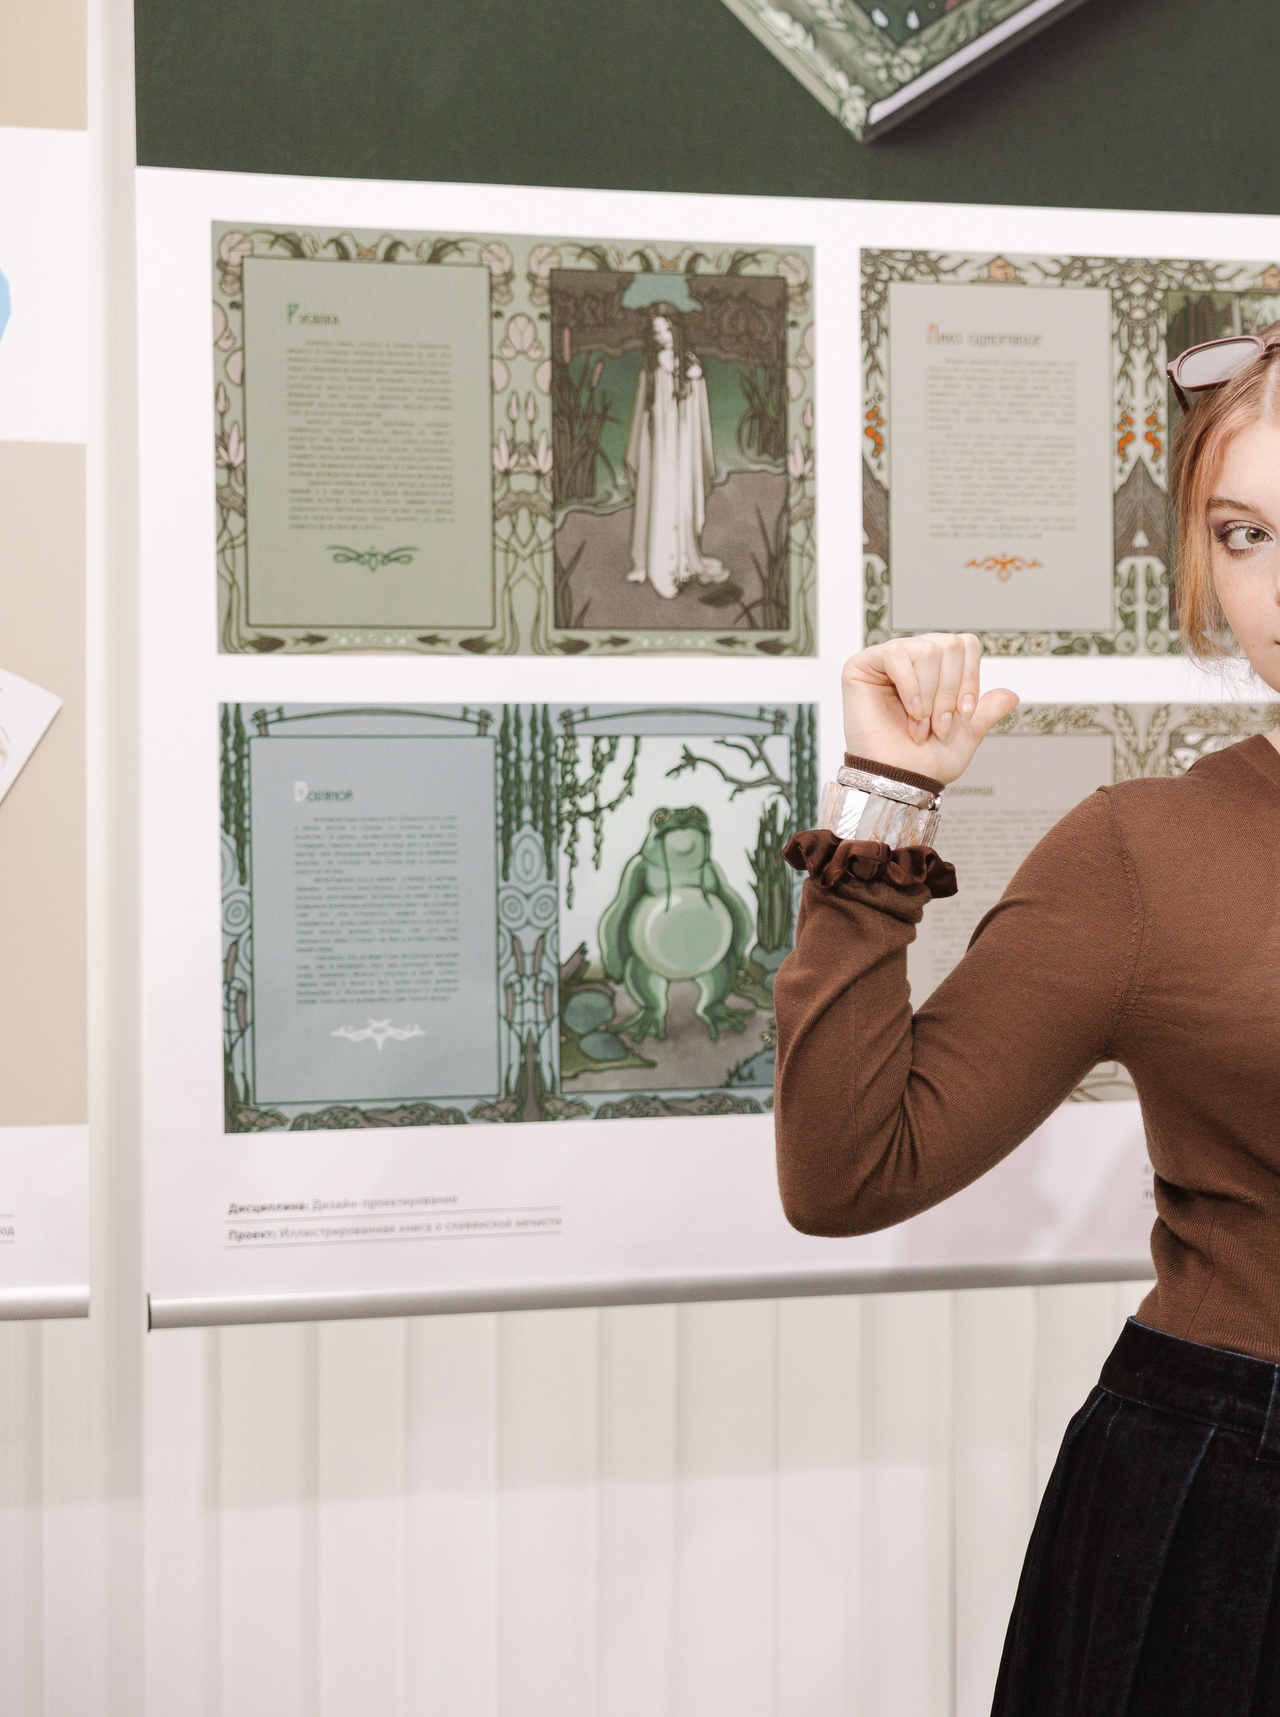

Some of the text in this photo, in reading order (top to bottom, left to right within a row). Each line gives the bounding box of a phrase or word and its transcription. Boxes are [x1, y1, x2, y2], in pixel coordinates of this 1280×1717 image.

[228, 1202, 309, 1215] Дисциплина:
[227, 1228, 277, 1242] Проект:
[279, 1225, 395, 1239] Иллюстрированная
[399, 1222, 432, 1233] книга
[445, 1218, 513, 1231] славянской
[516, 1218, 562, 1228] нечисти
